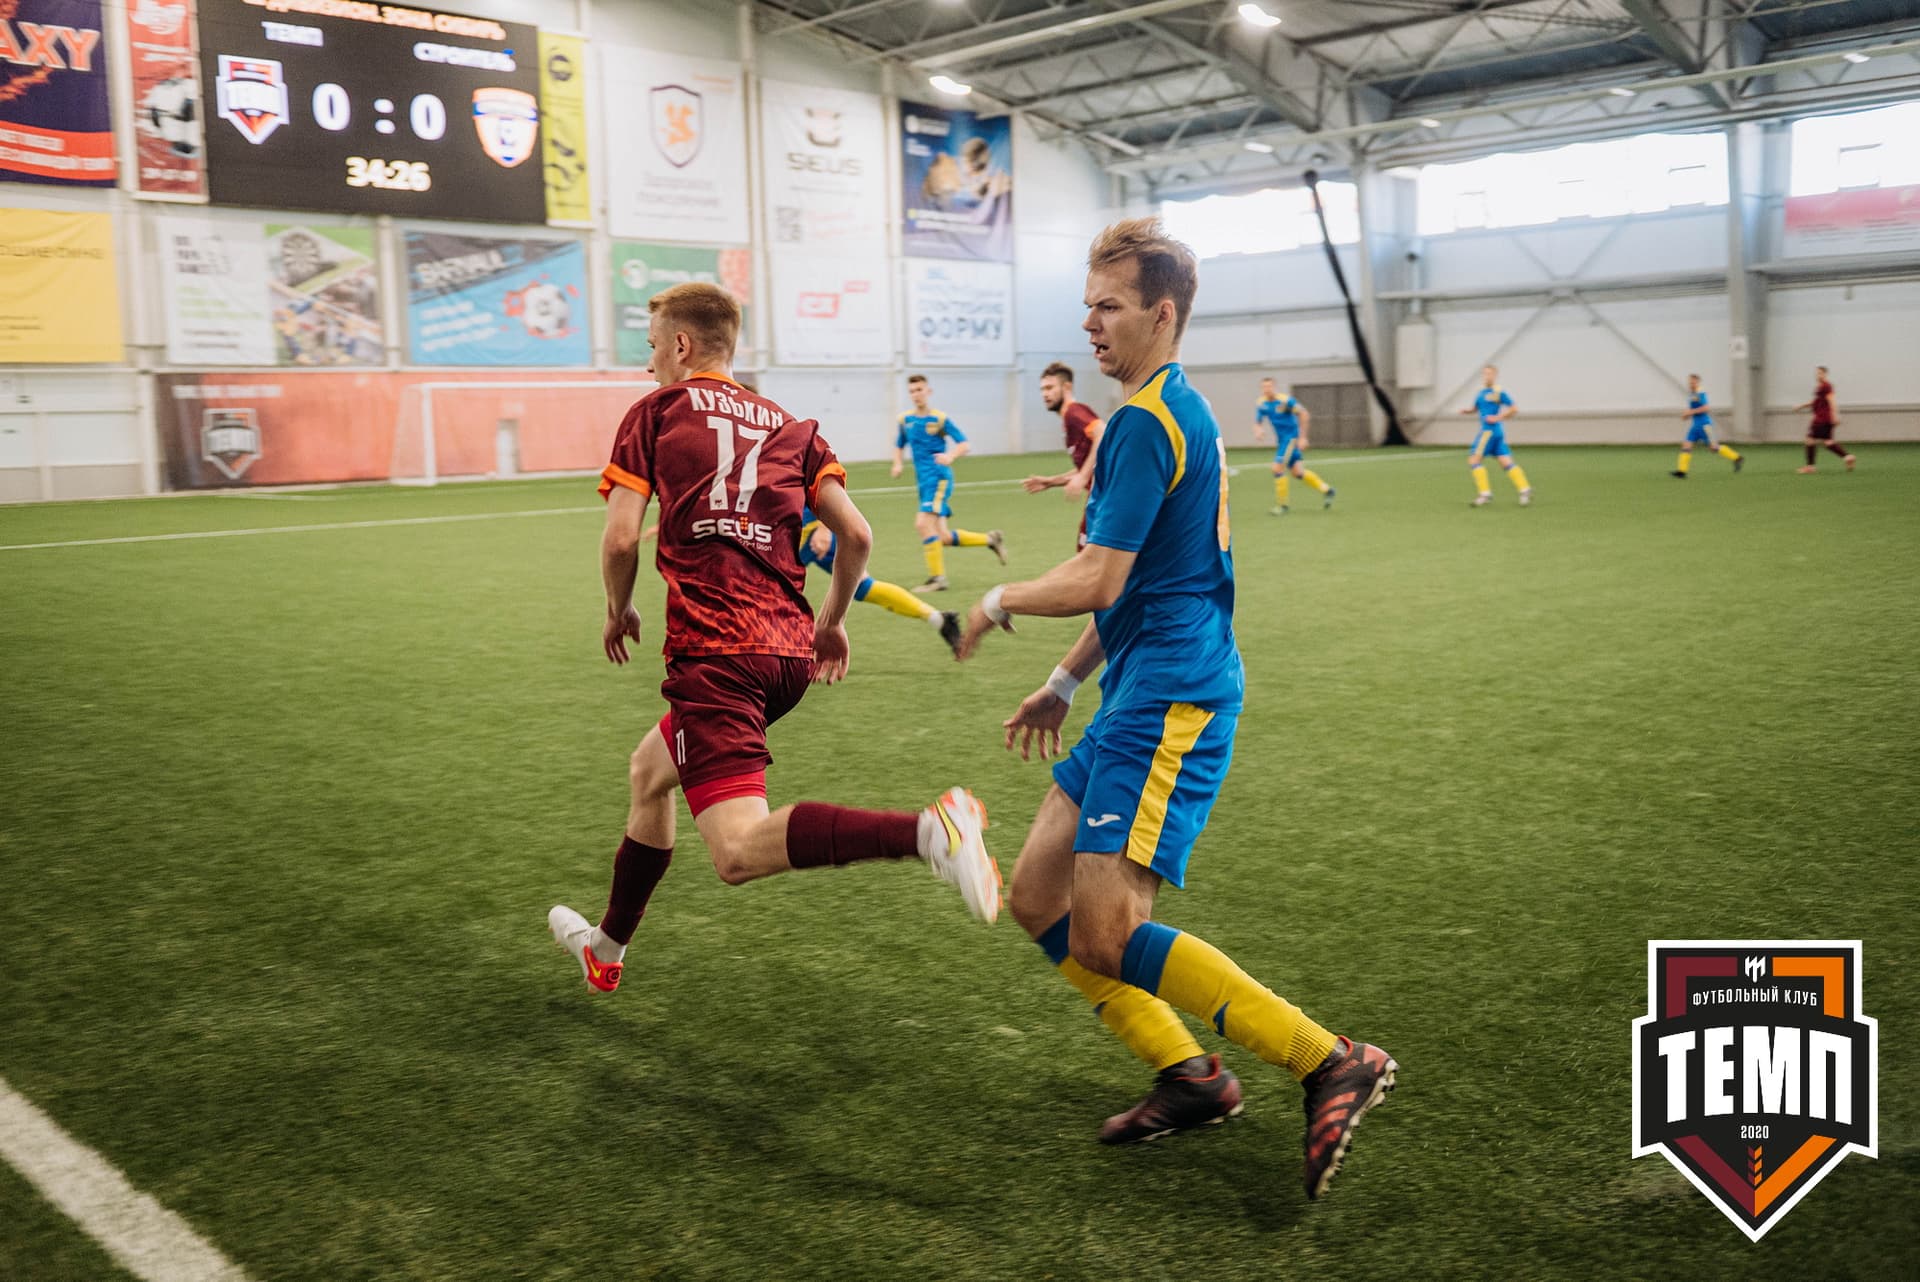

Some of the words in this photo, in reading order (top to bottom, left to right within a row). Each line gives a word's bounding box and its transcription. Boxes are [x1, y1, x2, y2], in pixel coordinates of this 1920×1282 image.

[312, 82, 351, 131] 0
[409, 93, 447, 140] 0
[345, 156, 432, 191] 34:26
[686, 386, 784, 430] КУЗЬКИН
[706, 415, 770, 513] 17
